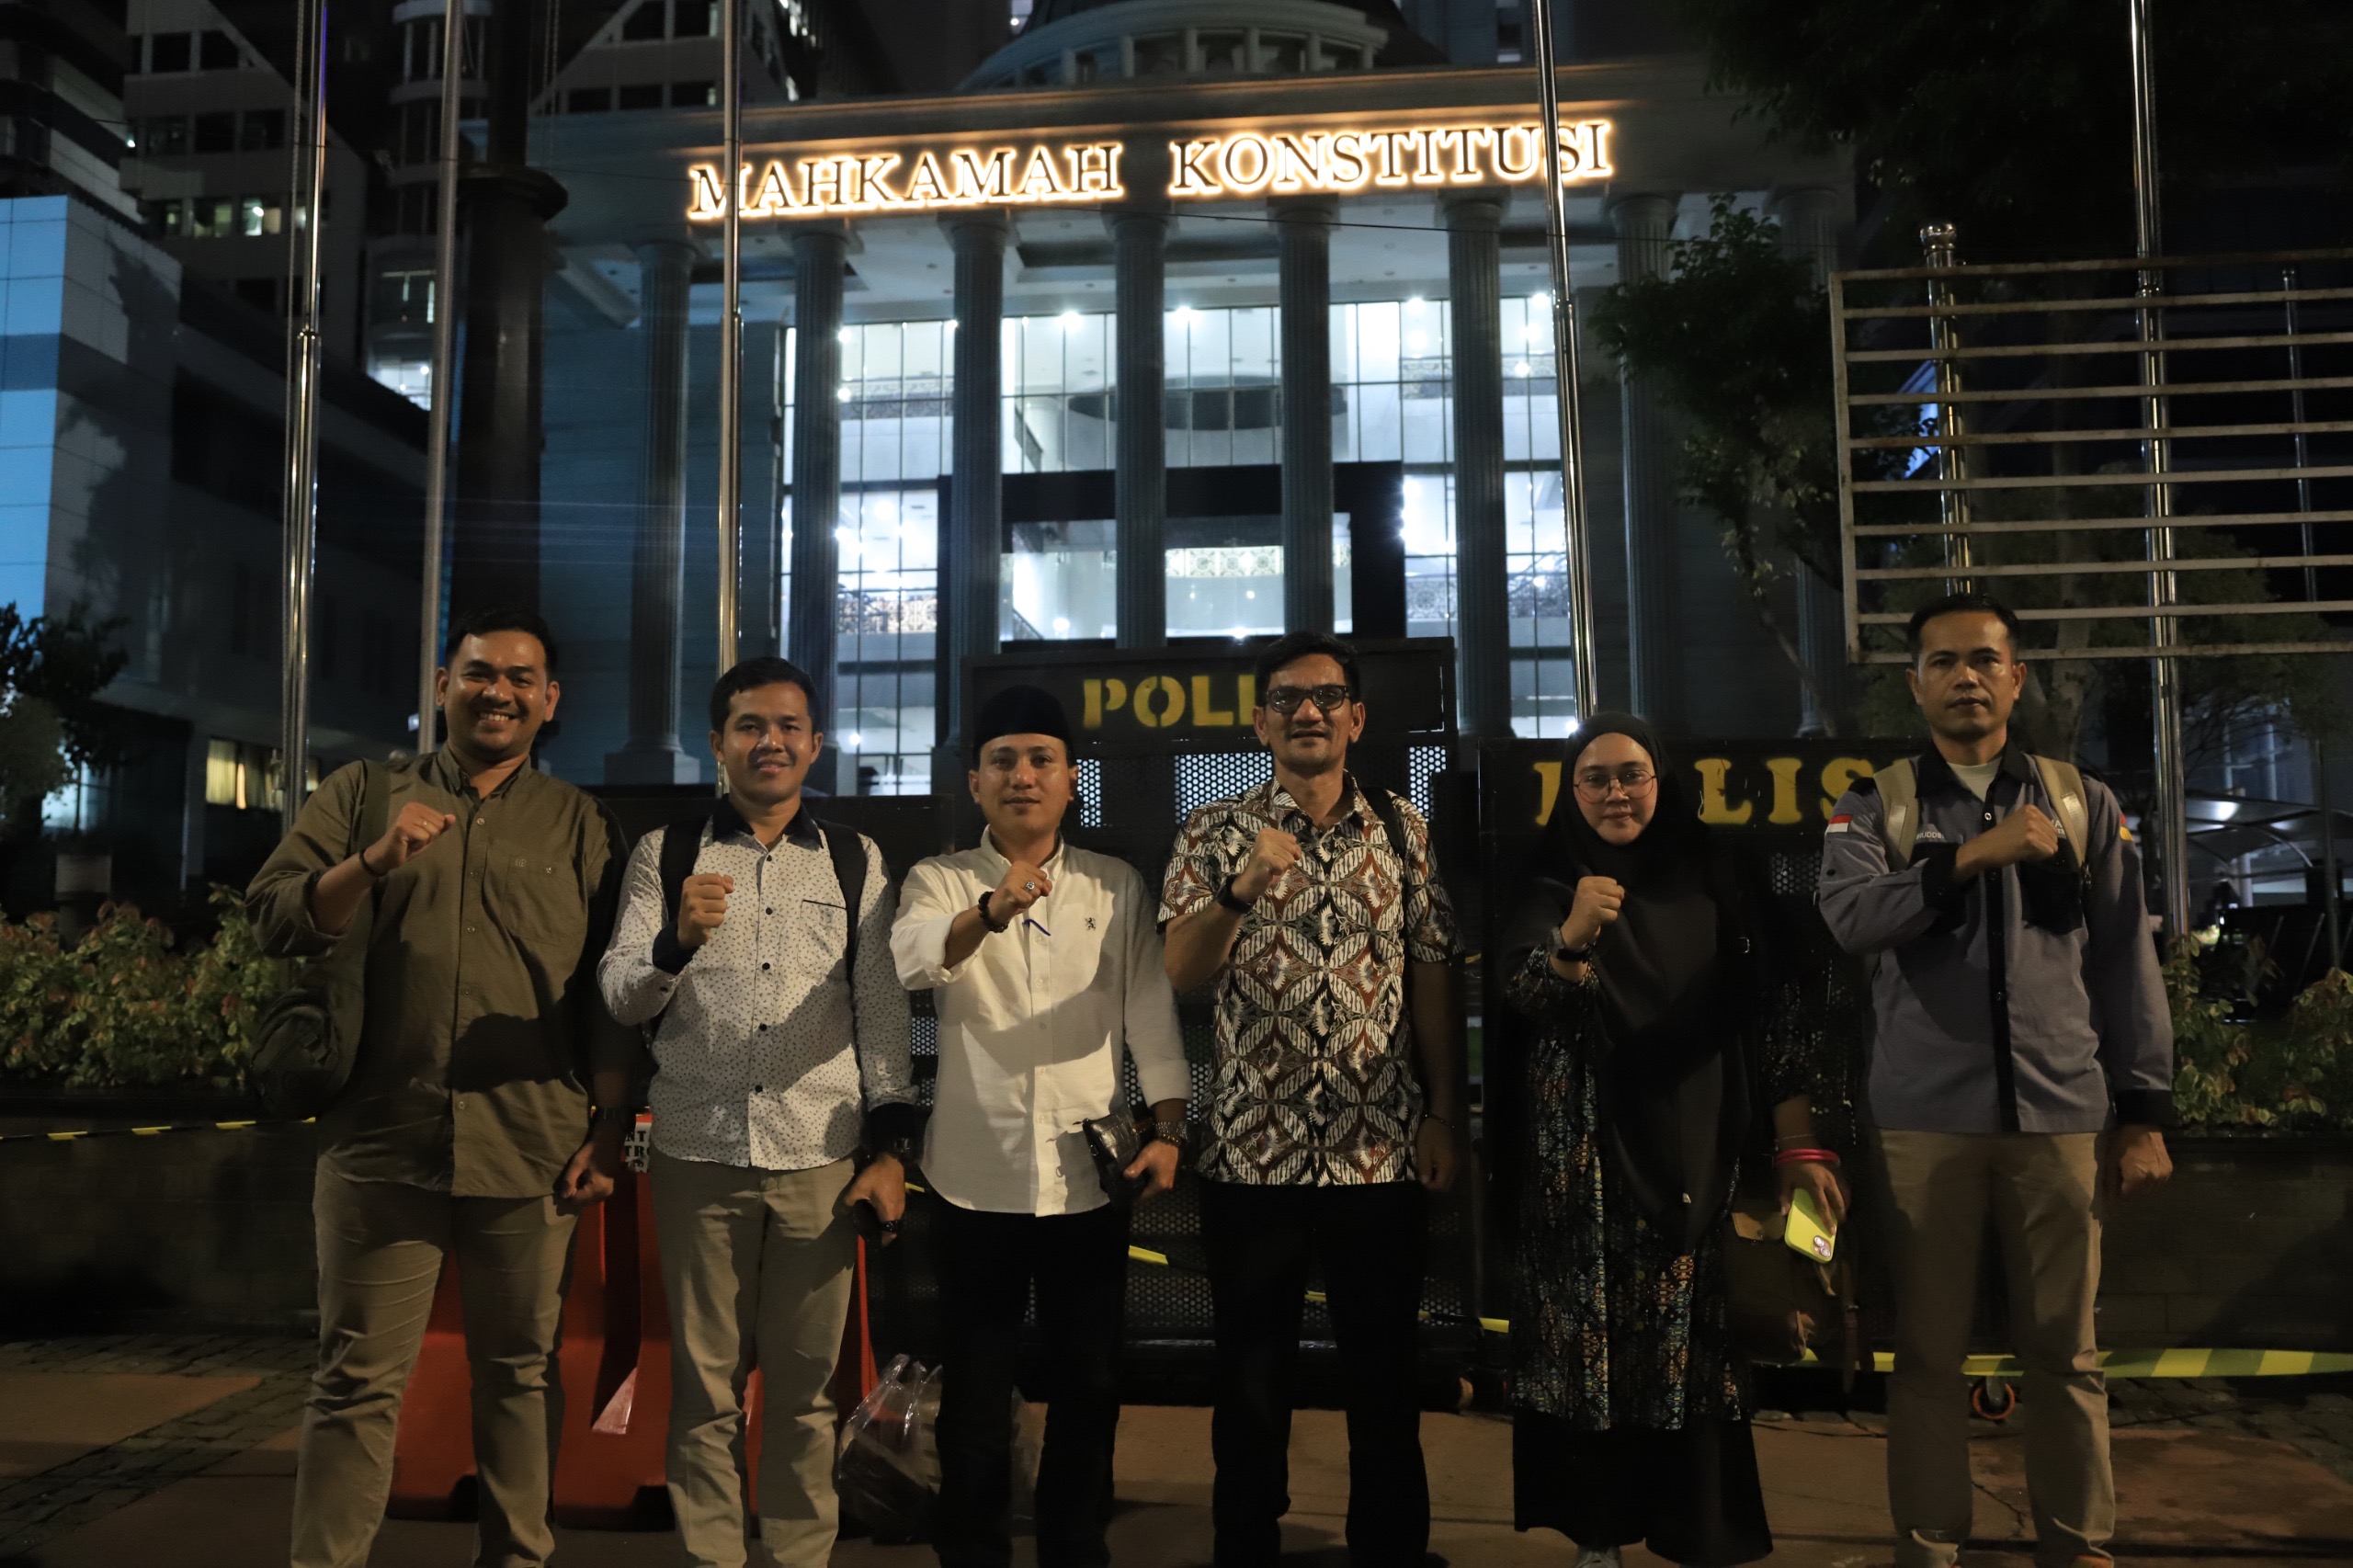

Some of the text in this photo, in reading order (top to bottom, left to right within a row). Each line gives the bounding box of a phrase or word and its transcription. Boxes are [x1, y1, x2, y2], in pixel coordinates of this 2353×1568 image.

[688, 120, 1612, 218] MAHKAMAH KONSTITUSI
[1083, 674, 1257, 731] POLI
